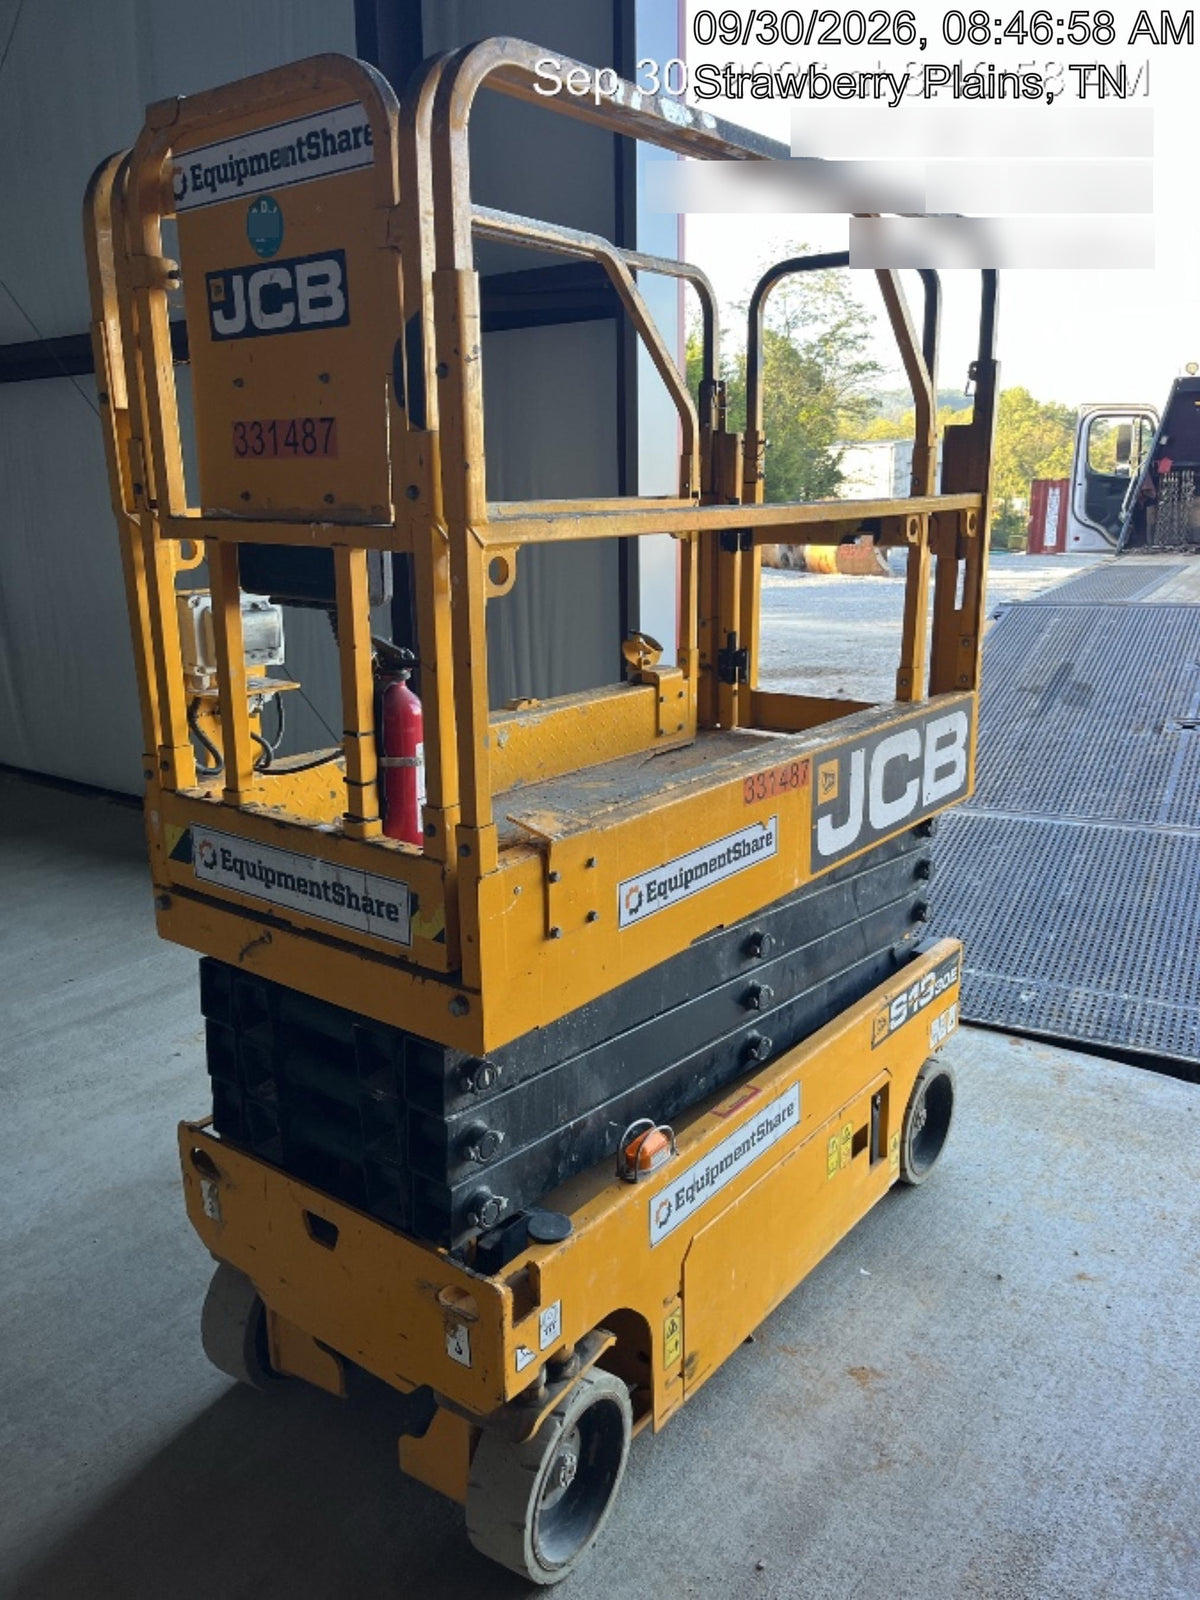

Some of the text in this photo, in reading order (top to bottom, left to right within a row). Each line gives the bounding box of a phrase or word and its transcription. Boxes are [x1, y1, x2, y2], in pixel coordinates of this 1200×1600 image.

[212, 258, 346, 336] JCB
[233, 417, 336, 457] 331487
[743, 758, 811, 805] 331487
[817, 711, 968, 856] JCB
[219, 847, 400, 923] EquipmentShare
[645, 831, 774, 905] EquipmentShare
[674, 1101, 795, 1212] EquipmentShare
